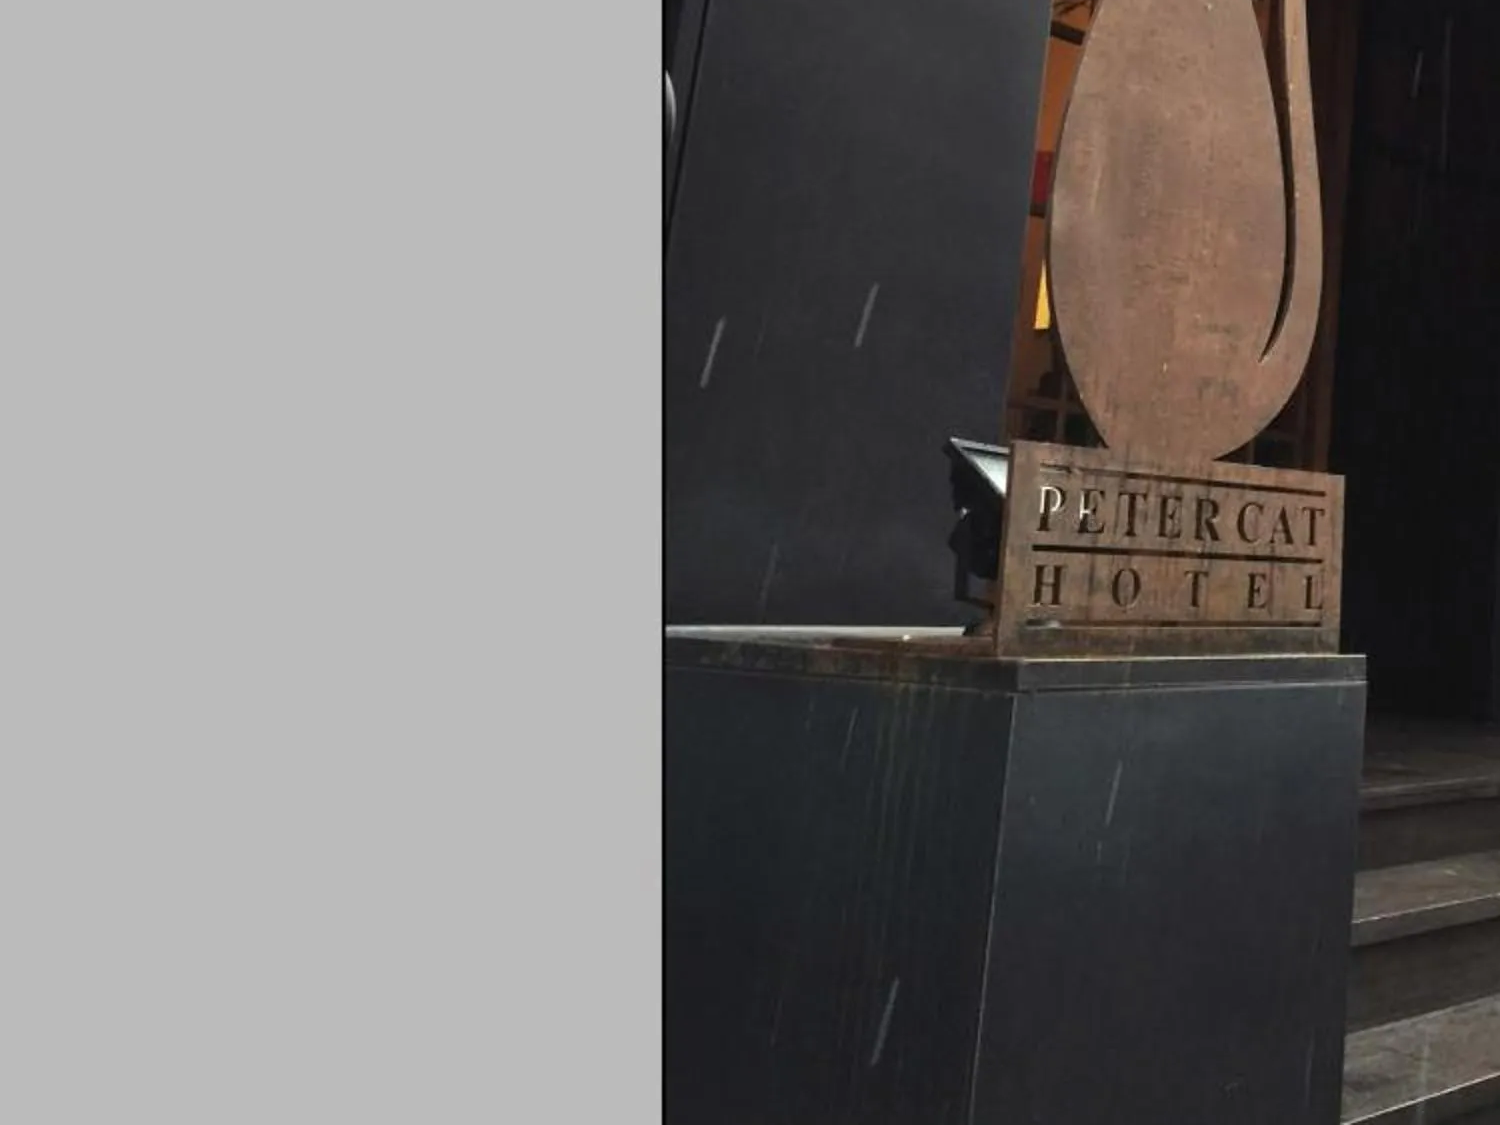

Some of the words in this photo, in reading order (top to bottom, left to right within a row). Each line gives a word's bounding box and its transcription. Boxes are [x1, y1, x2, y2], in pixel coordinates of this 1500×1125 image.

[1036, 486, 1222, 542] PETER
[1236, 501, 1325, 546] CAT
[1032, 564, 1324, 611] HOTEL
